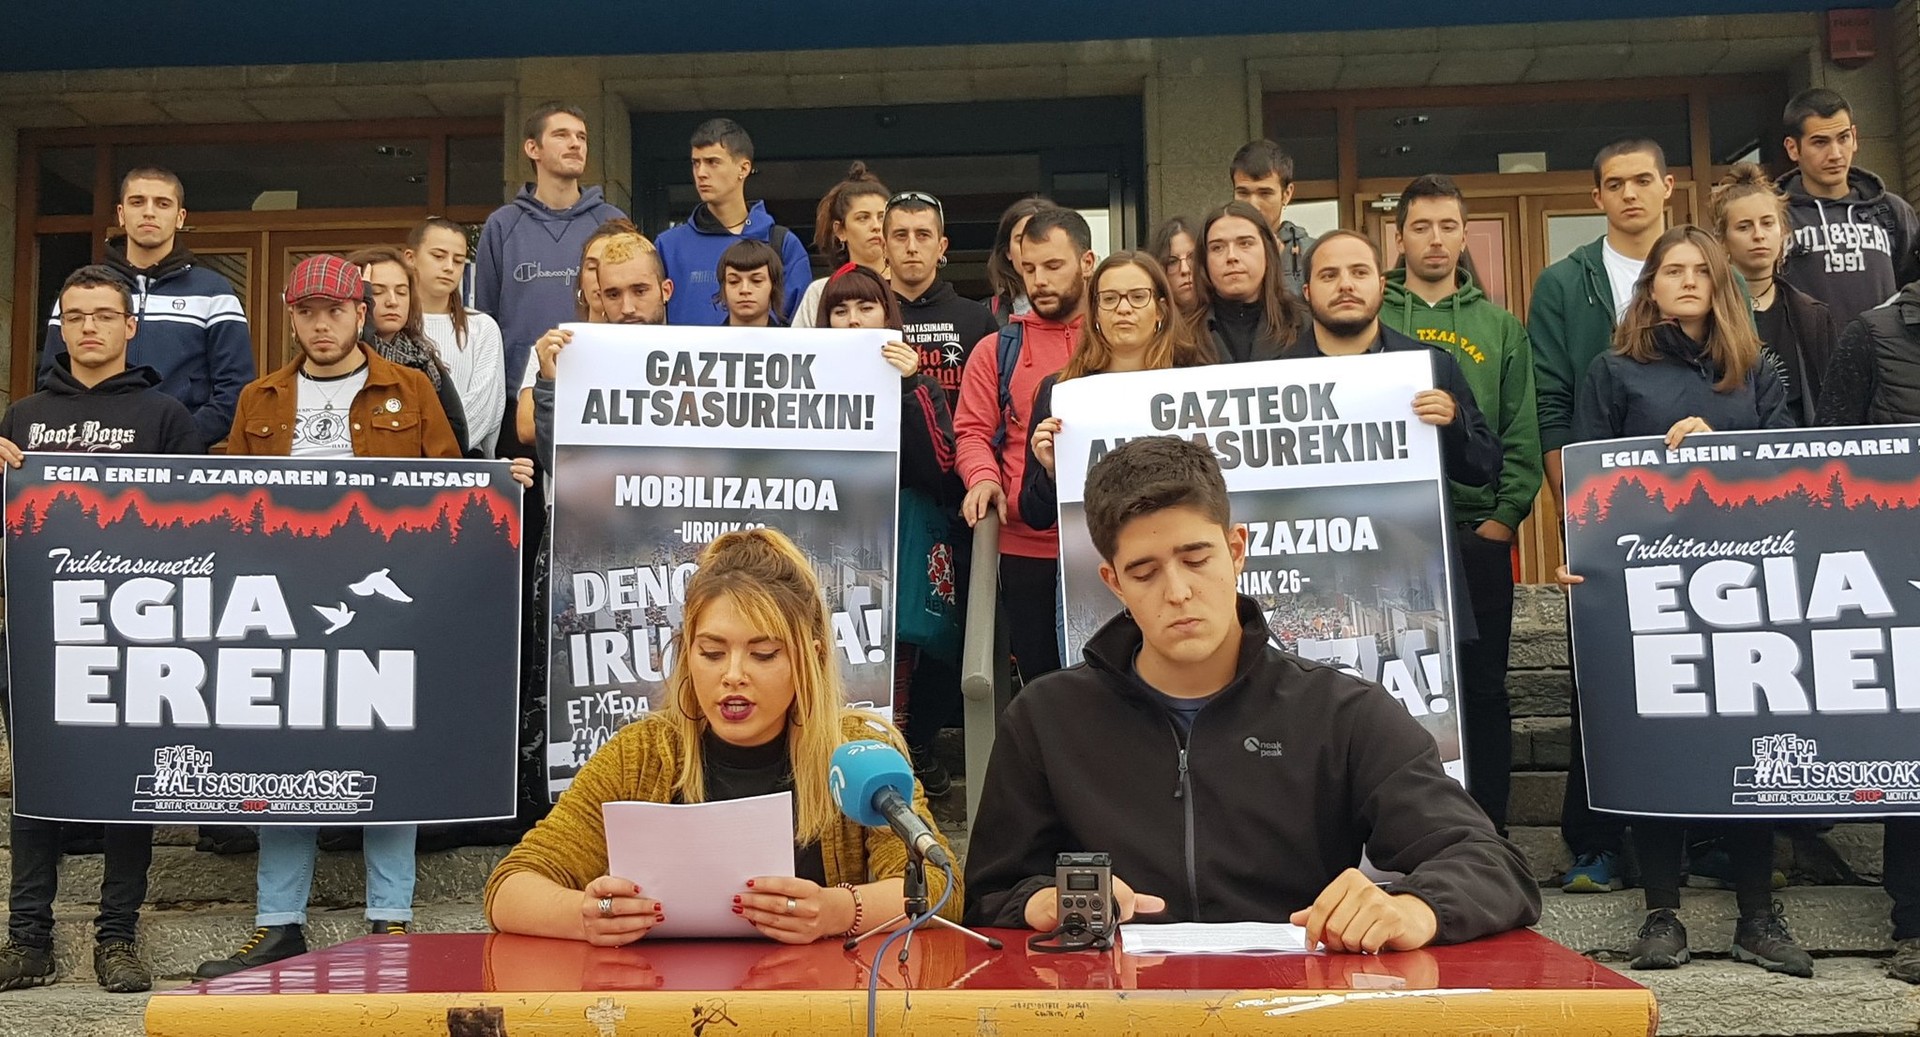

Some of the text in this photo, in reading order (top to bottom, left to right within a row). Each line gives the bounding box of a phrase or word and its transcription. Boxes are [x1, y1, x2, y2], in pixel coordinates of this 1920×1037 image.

[514, 261, 580, 286] Champi
[1824, 252, 1865, 272] 1991
[646, 351, 816, 389] GAZTEOK
[581, 389, 875, 430] ALTSASUREKIN!
[1150, 382, 1339, 430] GAZTEOK
[28, 421, 136, 449] Boot Boys
[1087, 421, 1408, 476] ASUREKIN!
[1602, 450, 1659, 467] EGIA
[1666, 446, 1736, 463] EREIN
[1756, 439, 1910, 459] AZAROAREN
[44, 466, 99, 481] EGIA
[106, 468, 171, 483] EREIN
[189, 469, 328, 485] AZAROAREN
[336, 471, 375, 486] 2an
[392, 473, 490, 487] ALTSASU
[615, 475, 839, 511] MOBILIZAZIOA
[1244, 516, 1379, 557] IZAZIOA
[1617, 530, 1795, 561] Txikitasunetik
[48, 548, 215, 575] Txikitasunetik
[573, 562, 700, 614] DENO
[1624, 551, 1895, 632] EGIA
[53, 575, 297, 642] EGIA
[1633, 628, 1920, 715] EREI
[55, 646, 415, 728] EREIN
[155, 746, 213, 766] ETXERA
[1753, 735, 1816, 757] ETXERA
[154, 771, 361, 795] #ALTSASUKOAKASKE
[1754, 760, 1920, 784] #ALTSASUKOAK
[186, 802, 225, 811] POLIZIALIK
[229, 802, 239, 810] EZ
[242, 801, 267, 811] STOP
[270, 802, 311, 811] MONTAJES
[314, 802, 358, 811] POLICIALES
[1839, 793, 1850, 801] EZ
[1854, 791, 1882, 801] STOP
[1885, 792, 1920, 801] MONTAJ
